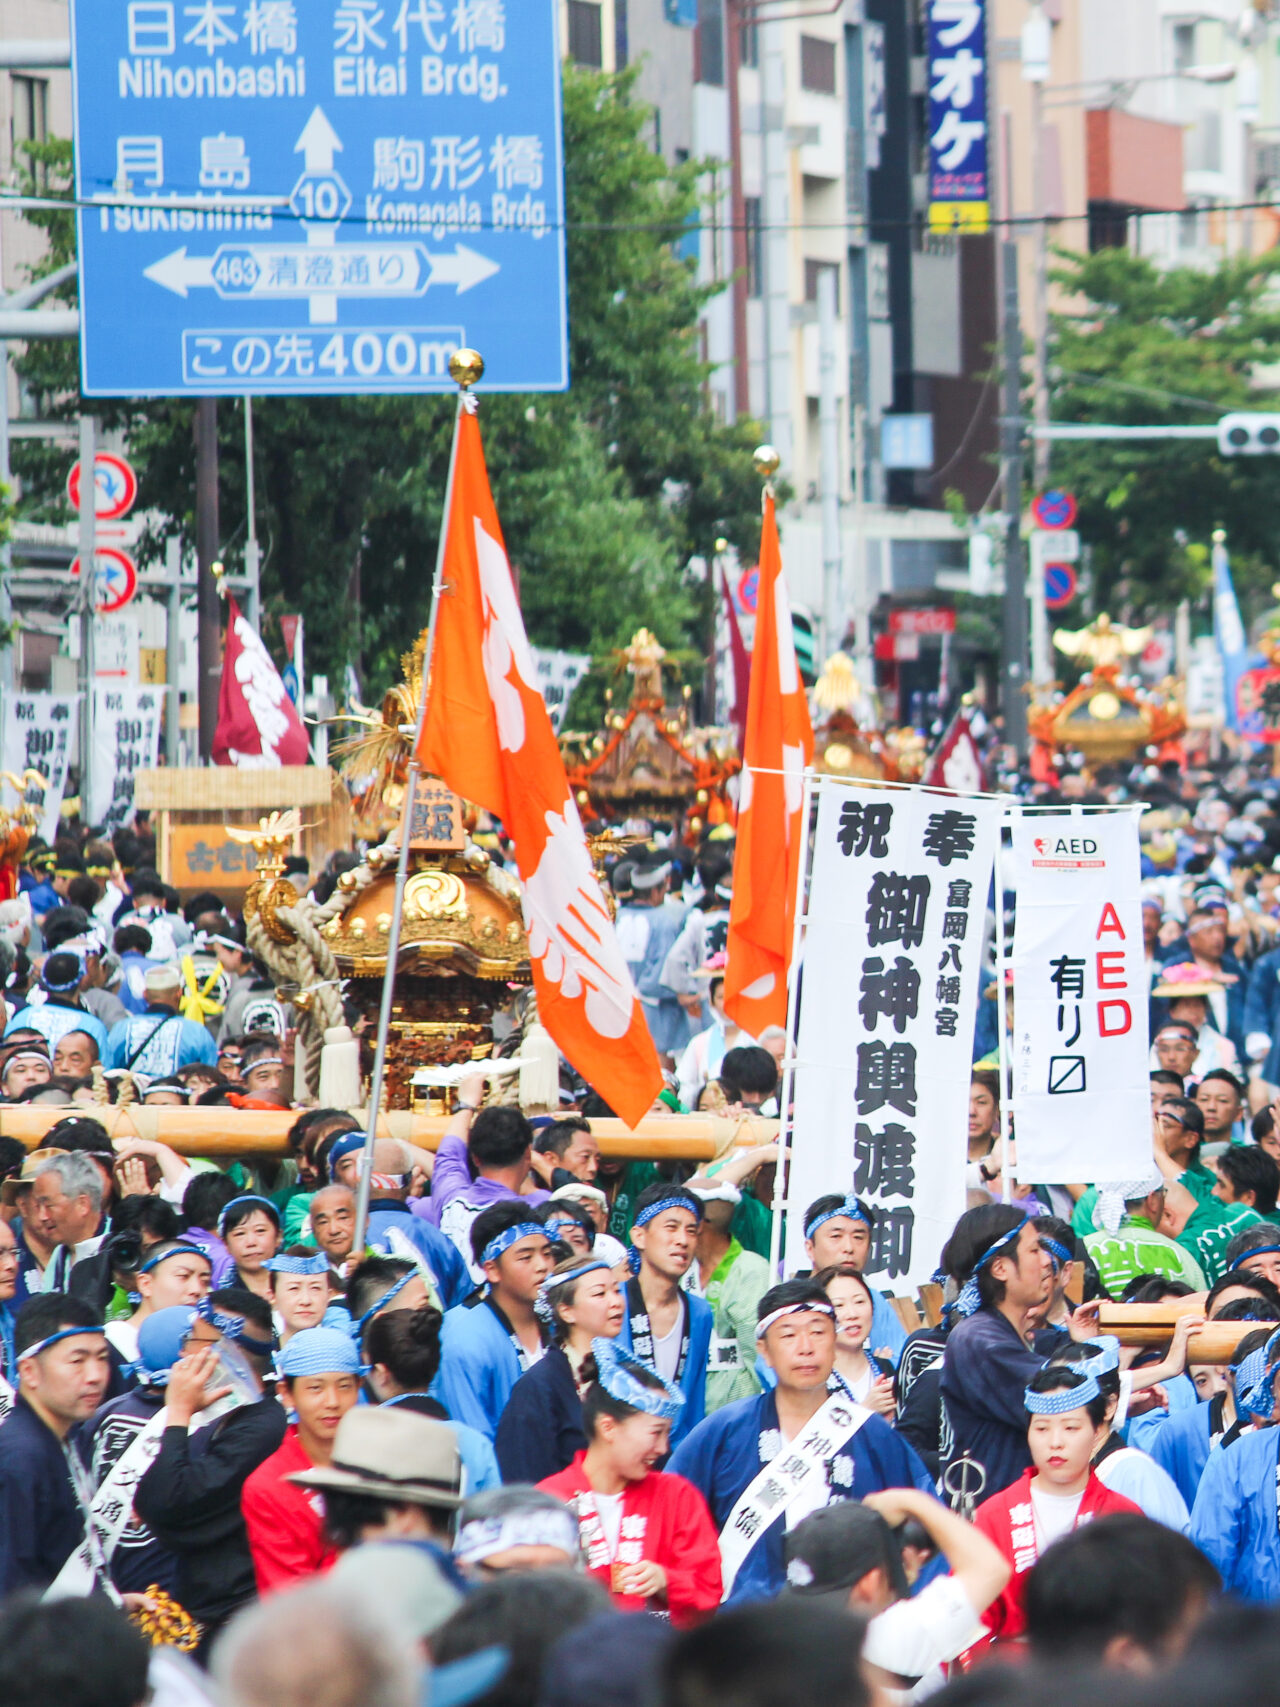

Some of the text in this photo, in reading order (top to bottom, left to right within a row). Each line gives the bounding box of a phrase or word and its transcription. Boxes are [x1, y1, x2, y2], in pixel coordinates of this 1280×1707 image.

[128, 1, 298, 55] 日本橋
[334, 1, 506, 53] 永代橋
[119, 58, 305, 97] Nihonbashi
[334, 57, 507, 102] Eitai Brdg.
[373, 135, 543, 190] 駒形橋
[299, 184, 339, 216] 10
[492, 192, 551, 239] Brdg.
[215, 254, 404, 285] 463 清澄通り
[1055, 838, 1097, 854] AED
[935, 878, 974, 1038] 富岡八幡宮
[1096, 902, 1132, 1038] AED
[853, 871, 931, 1297] 御神輿渡御
